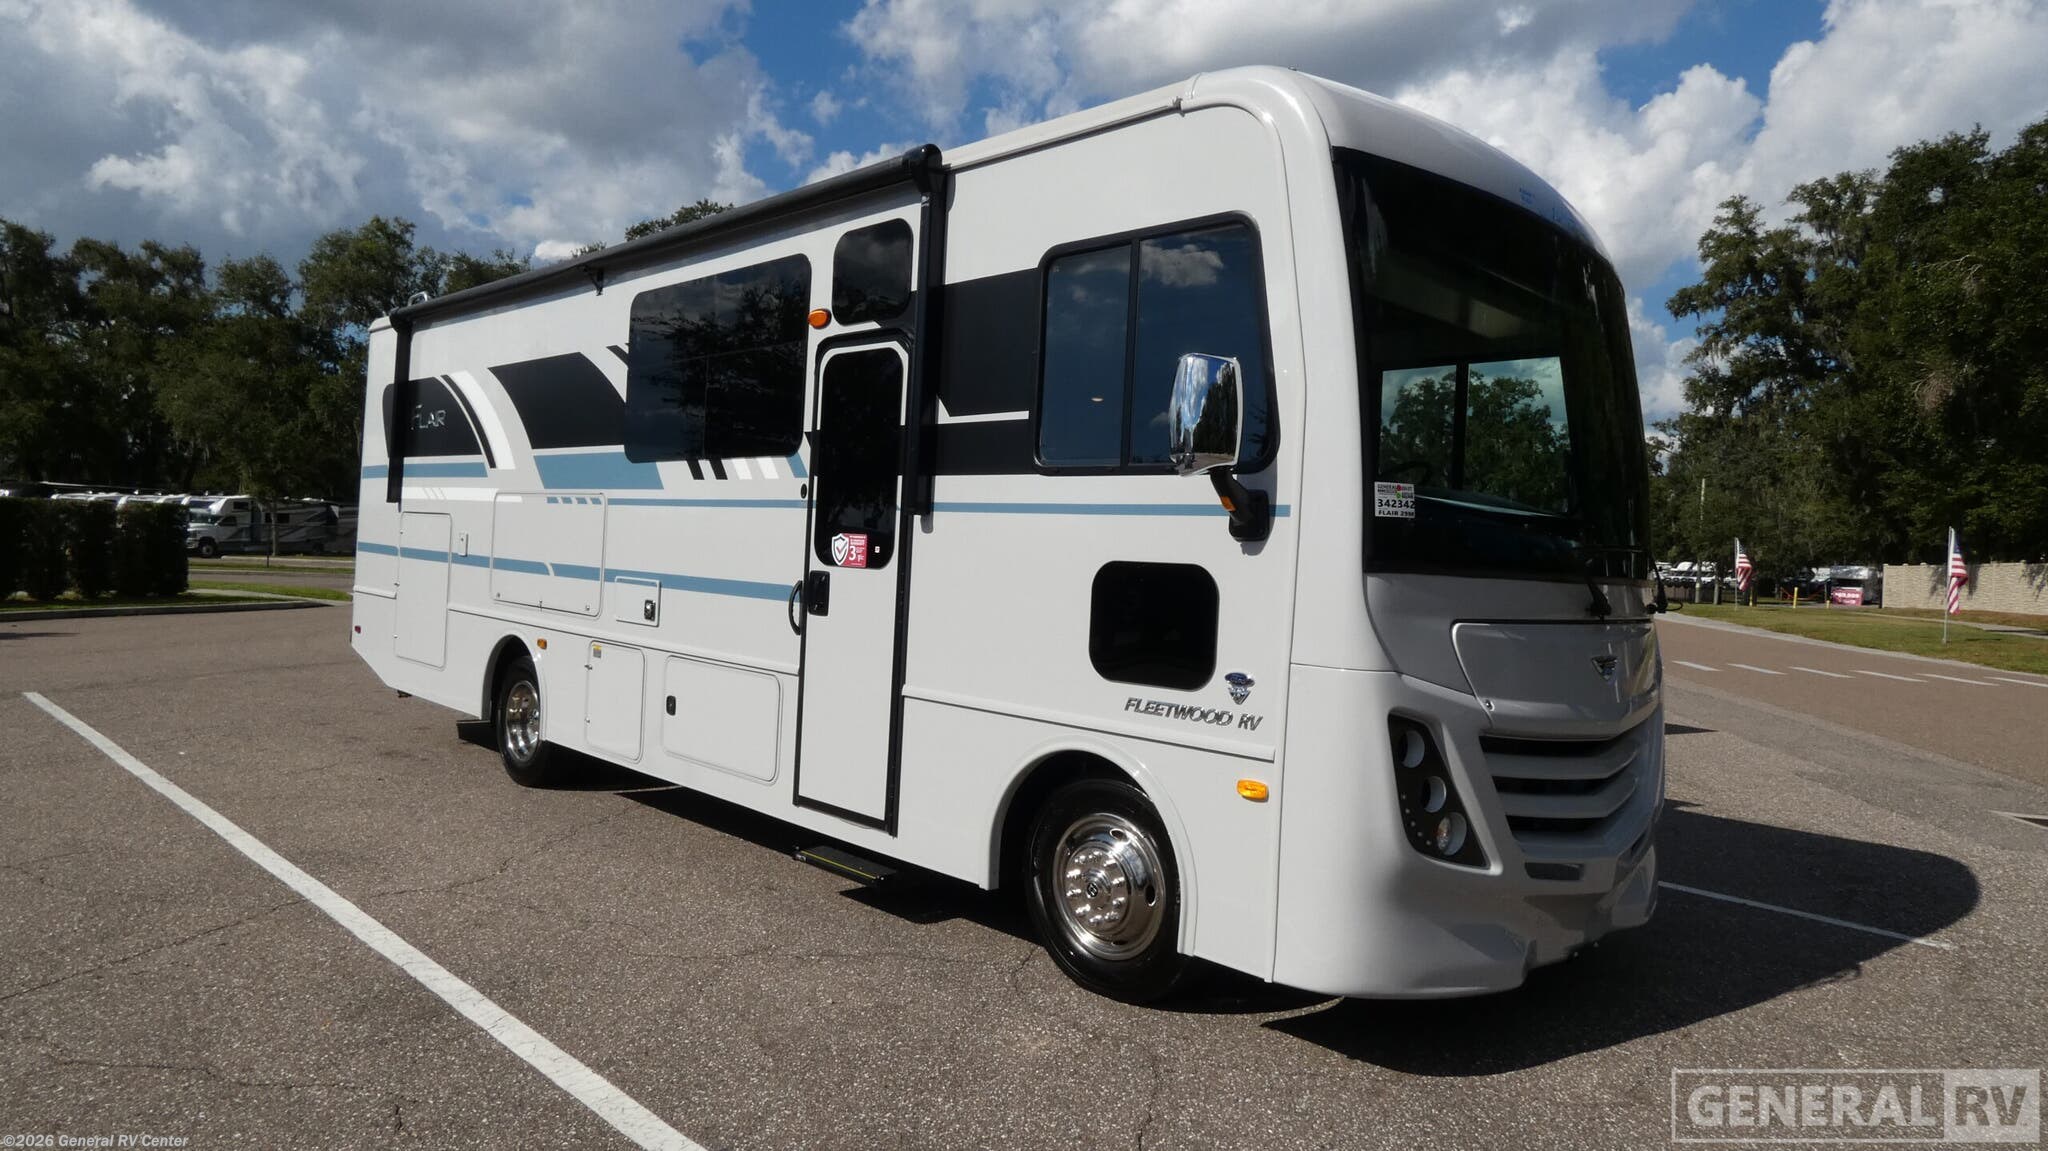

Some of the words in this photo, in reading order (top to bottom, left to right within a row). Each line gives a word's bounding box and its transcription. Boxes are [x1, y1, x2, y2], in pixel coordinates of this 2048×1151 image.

[1377, 498, 1416, 509] 342342
[848, 545, 856, 561] 3
[1124, 697, 1233, 726] FLEETWOOD
[1238, 712, 1263, 731] RV
